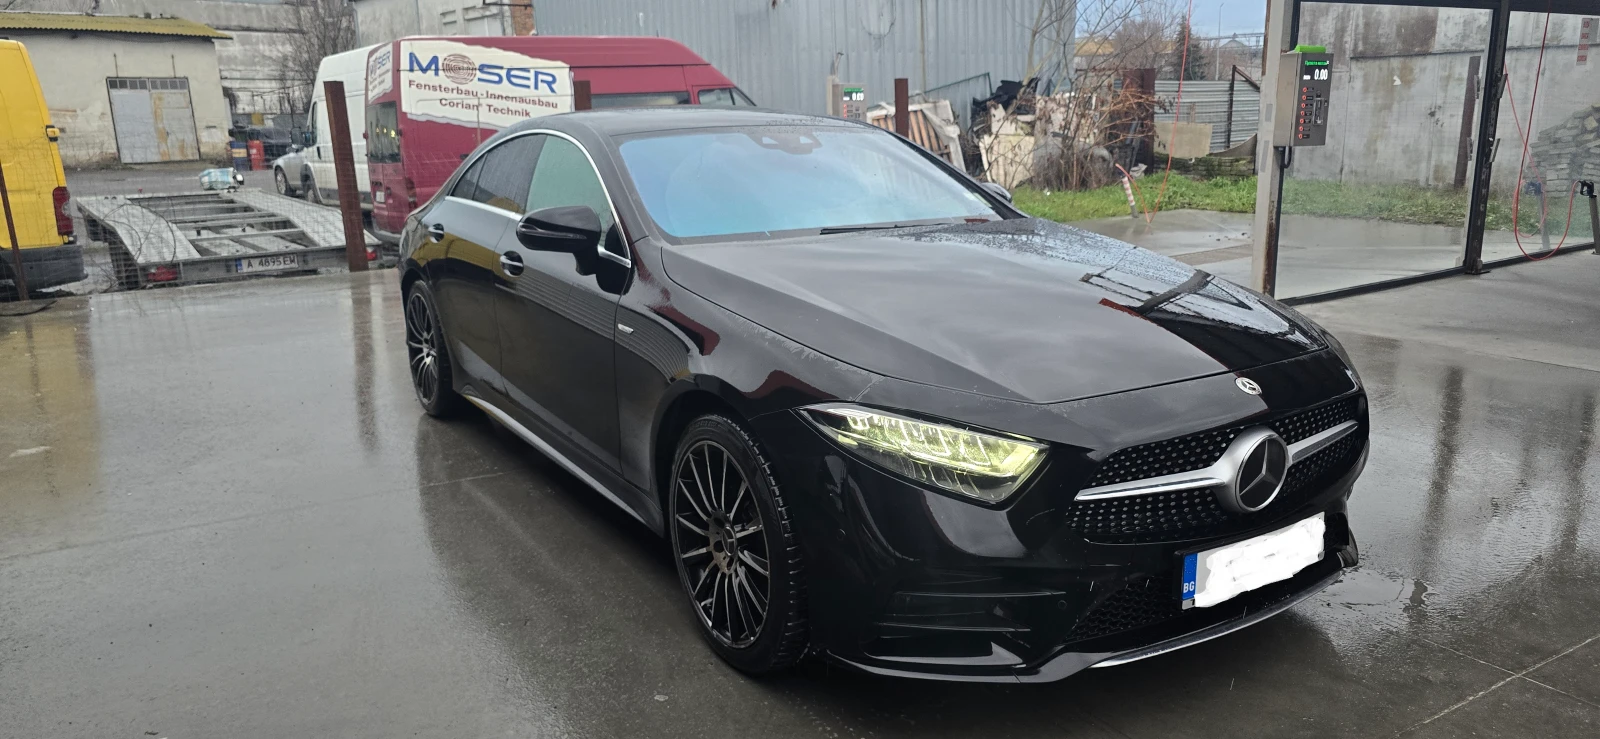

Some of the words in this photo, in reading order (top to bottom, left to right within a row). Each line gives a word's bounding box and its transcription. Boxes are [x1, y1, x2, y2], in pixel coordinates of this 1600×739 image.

[408, 52, 557, 94] MOSER
[1314, 68, 1329, 80] 0.00
[486, 103, 531, 118] Technik
[1183, 581, 1195, 594] BG
